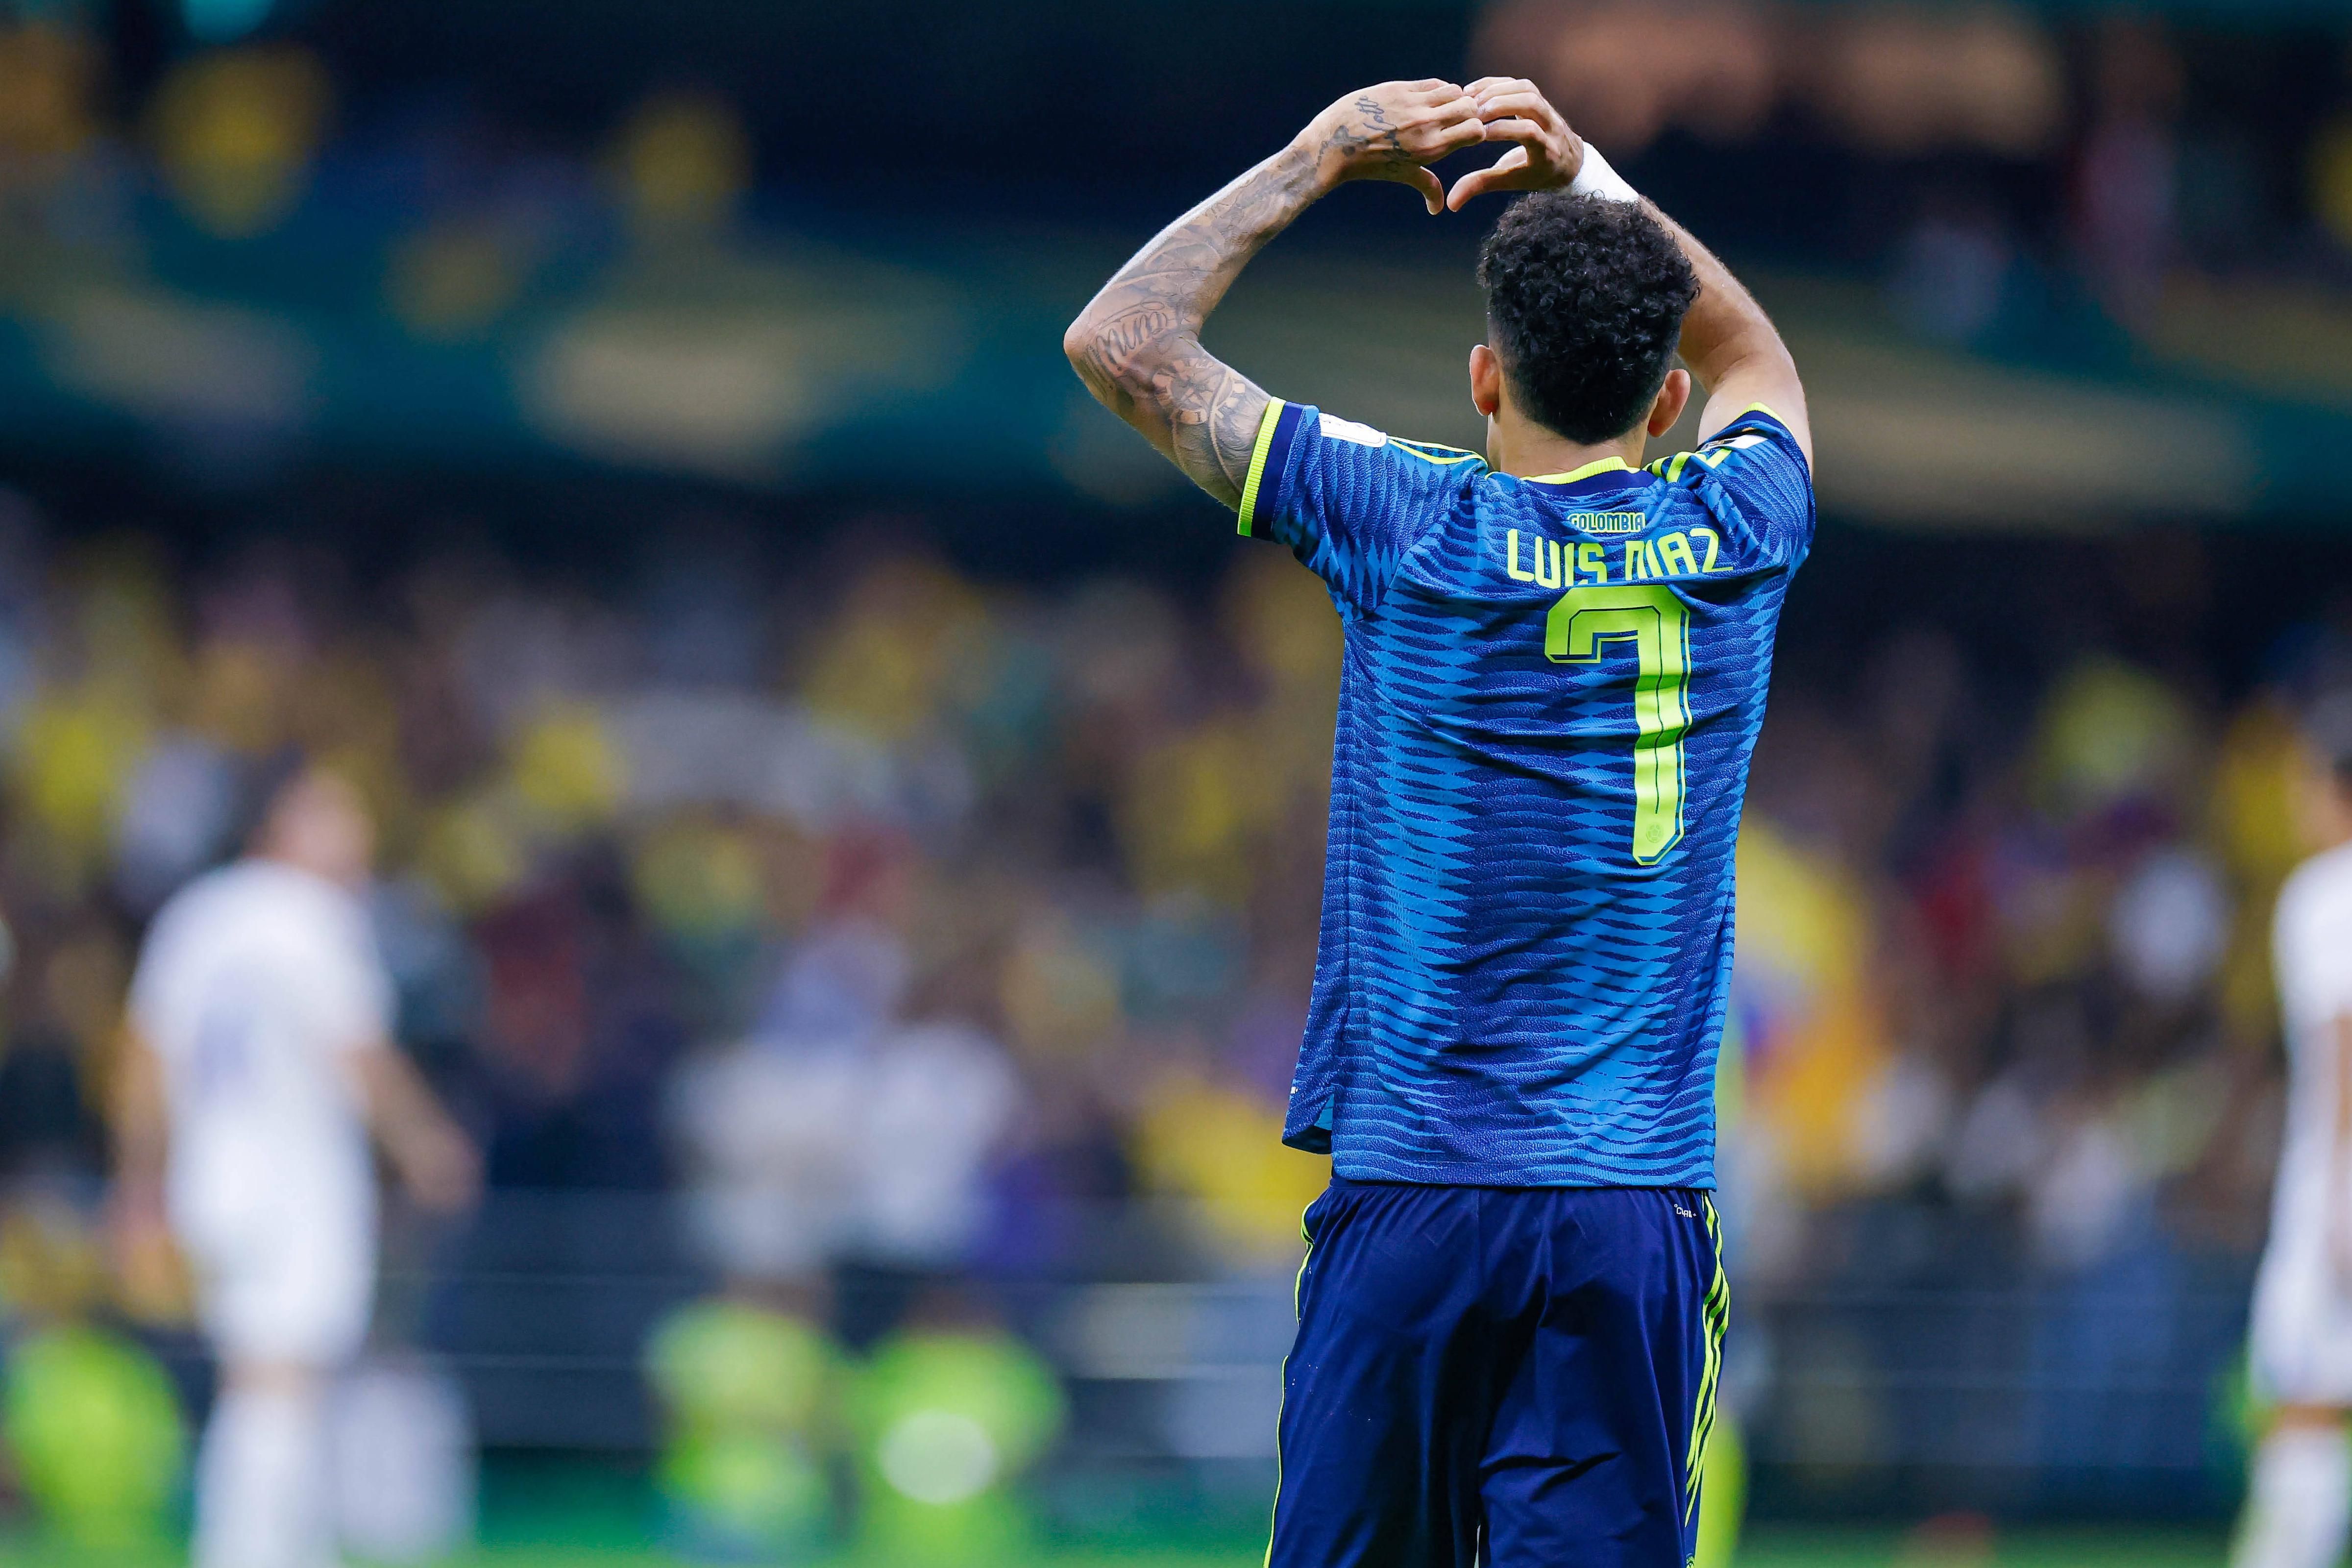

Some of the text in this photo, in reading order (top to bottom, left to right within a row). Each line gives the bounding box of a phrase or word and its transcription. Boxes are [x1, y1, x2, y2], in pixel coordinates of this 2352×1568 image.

[1507, 528, 1734, 589] LUIS DIAZ
[1544, 585, 1693, 865] 7
